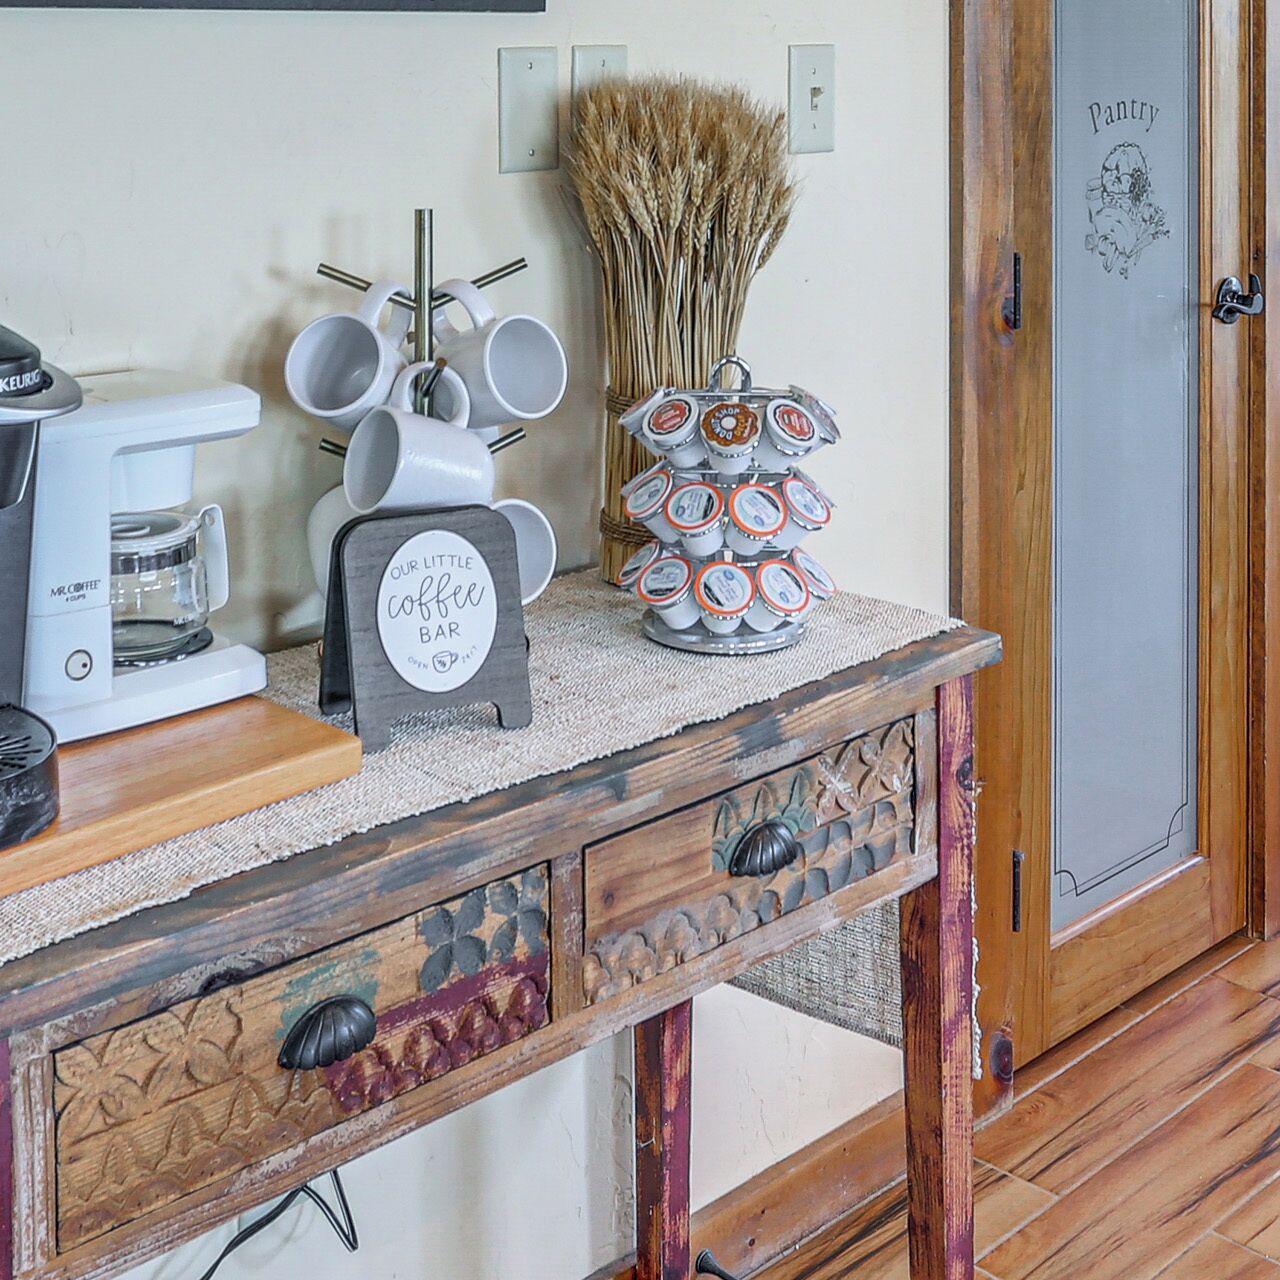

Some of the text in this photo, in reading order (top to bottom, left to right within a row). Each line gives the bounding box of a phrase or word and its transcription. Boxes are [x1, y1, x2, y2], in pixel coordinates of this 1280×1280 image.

[1088, 98, 1160, 135] Pantry
[390, 554, 474, 580] OUR LITTLE
[388, 572, 485, 622] coffee
[419, 621, 461, 644] BAR
